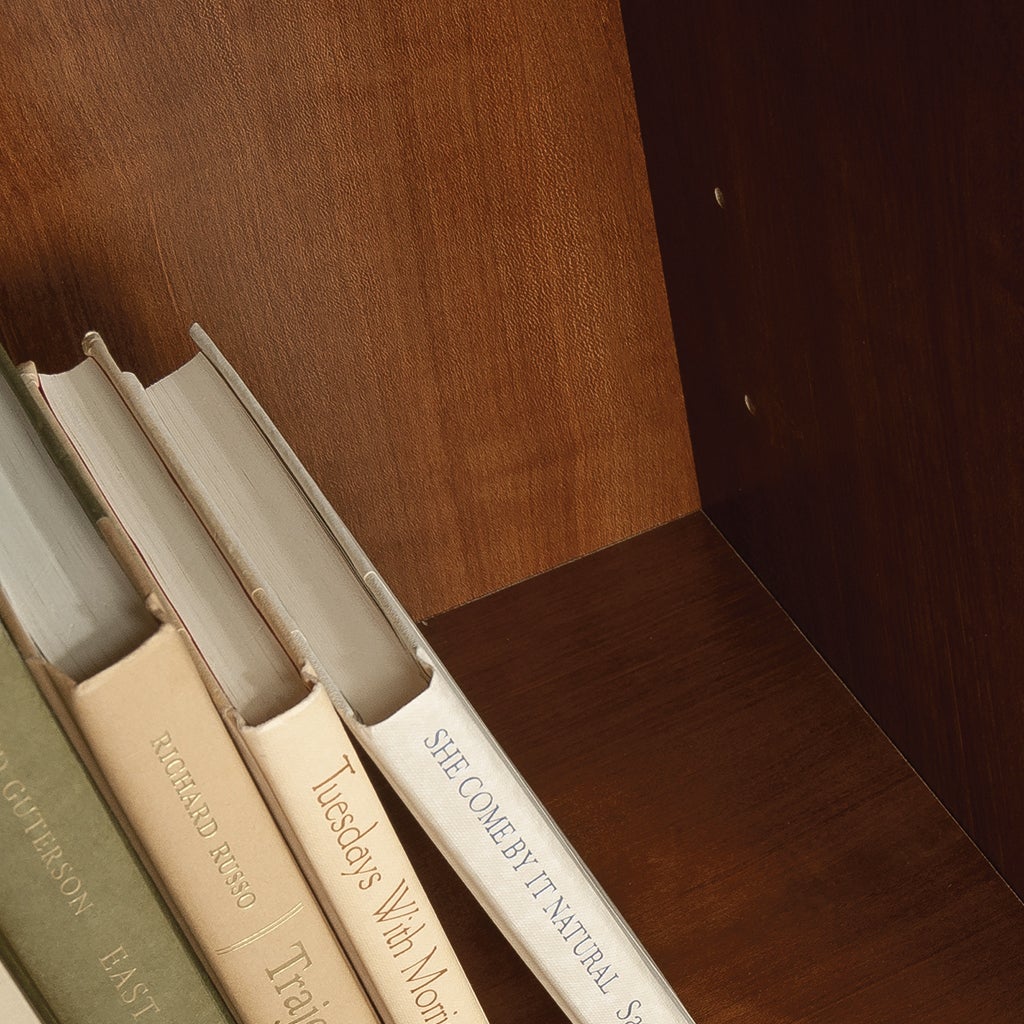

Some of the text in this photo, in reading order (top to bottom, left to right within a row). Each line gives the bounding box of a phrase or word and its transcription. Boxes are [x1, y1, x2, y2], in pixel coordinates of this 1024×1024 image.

[2, 779, 95, 917] GUTERSON
[151, 730, 257, 911] RICHARD RUSSO
[311, 753, 382, 891] Tuesdays
[371, 877, 427, 959] With
[423, 728, 620, 995] SHE COME BY IT NATURAL
[98, 945, 161, 1022] EAST
